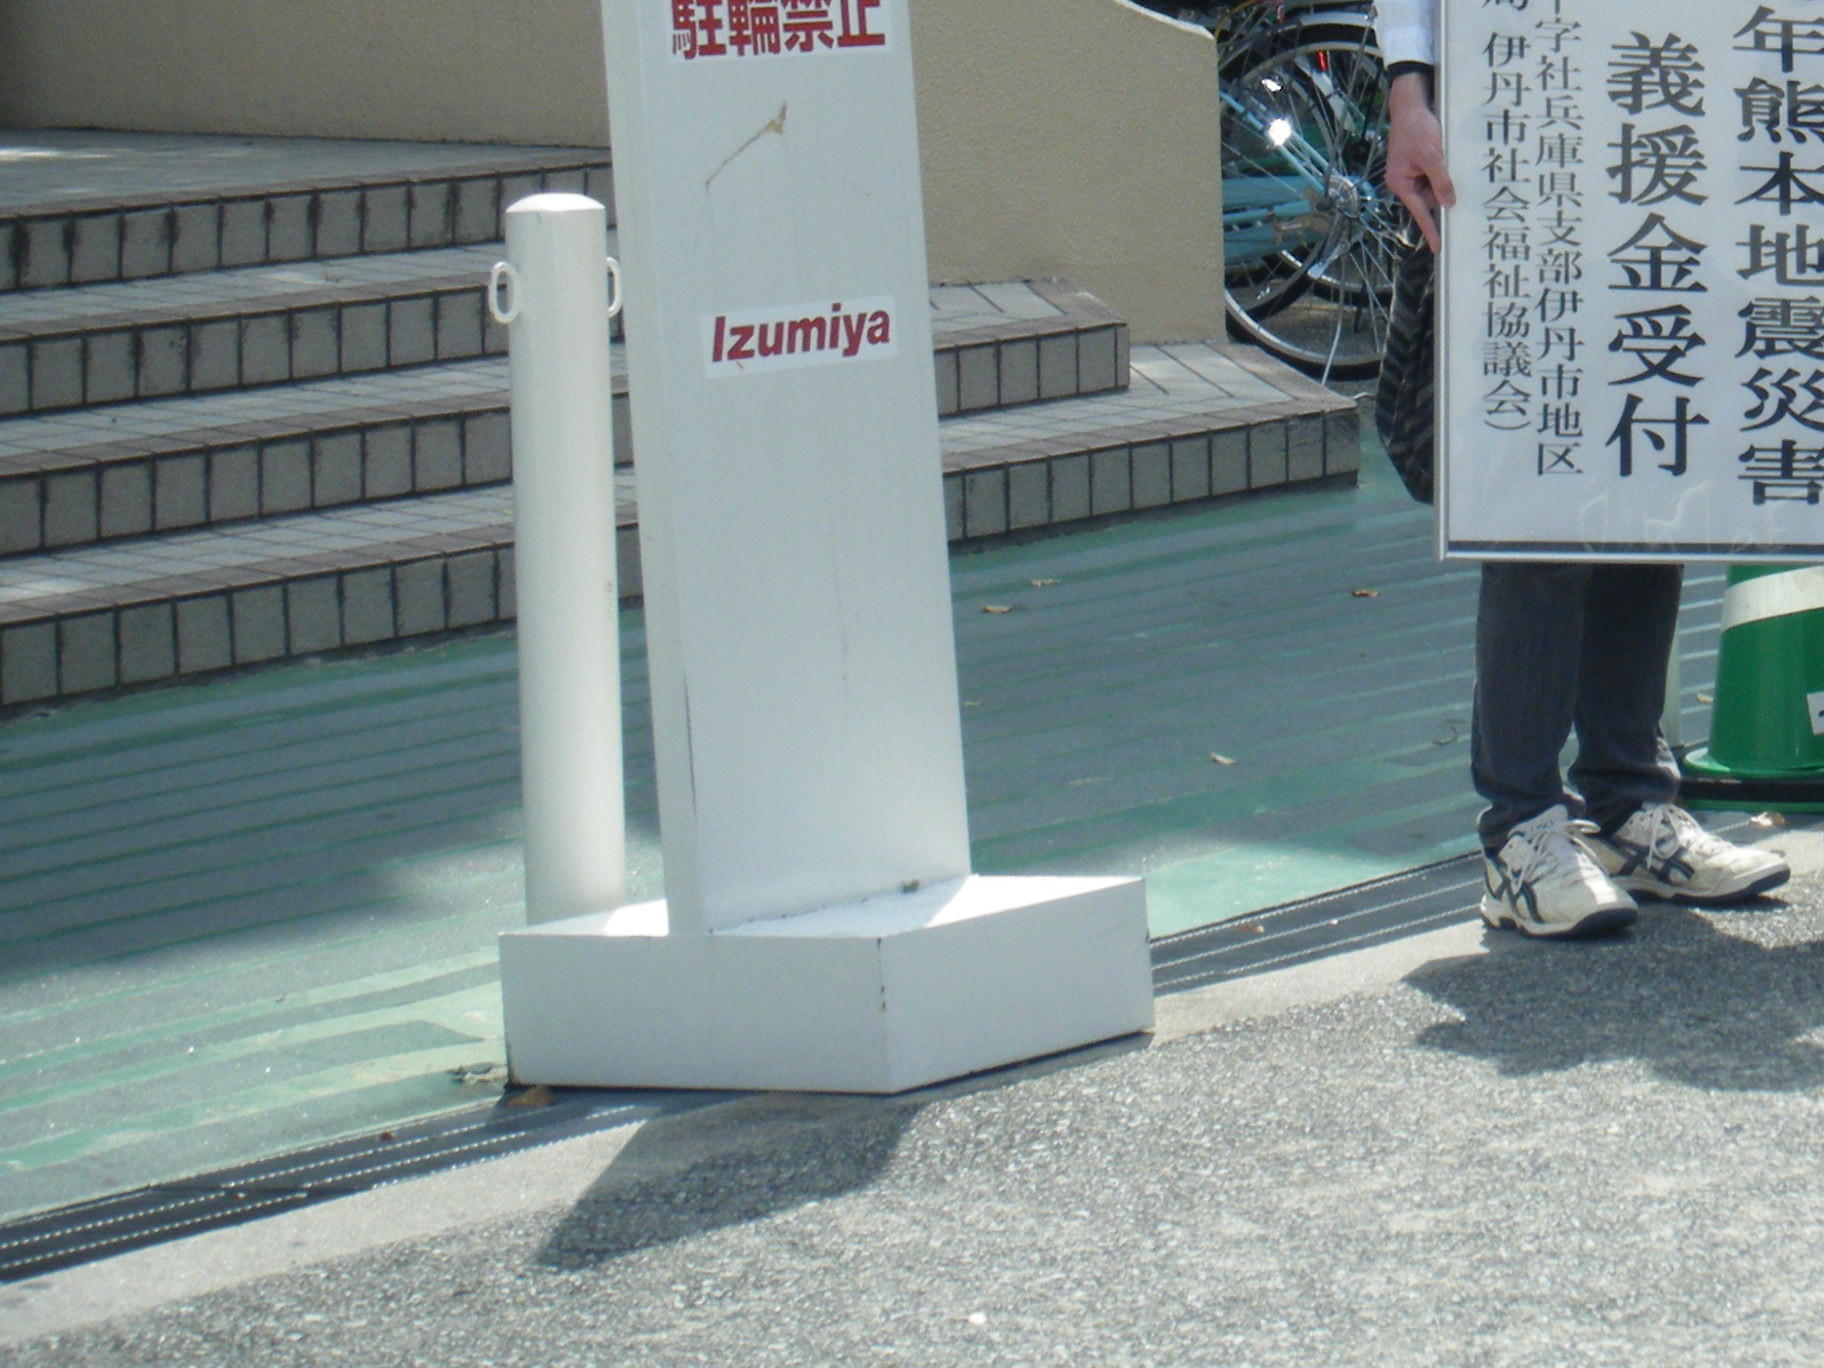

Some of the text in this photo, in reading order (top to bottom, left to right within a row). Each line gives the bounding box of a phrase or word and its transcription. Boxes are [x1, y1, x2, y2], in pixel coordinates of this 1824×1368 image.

[711, 301, 891, 364] Izumiya
[1604, 30, 1711, 478] 義援金受付
